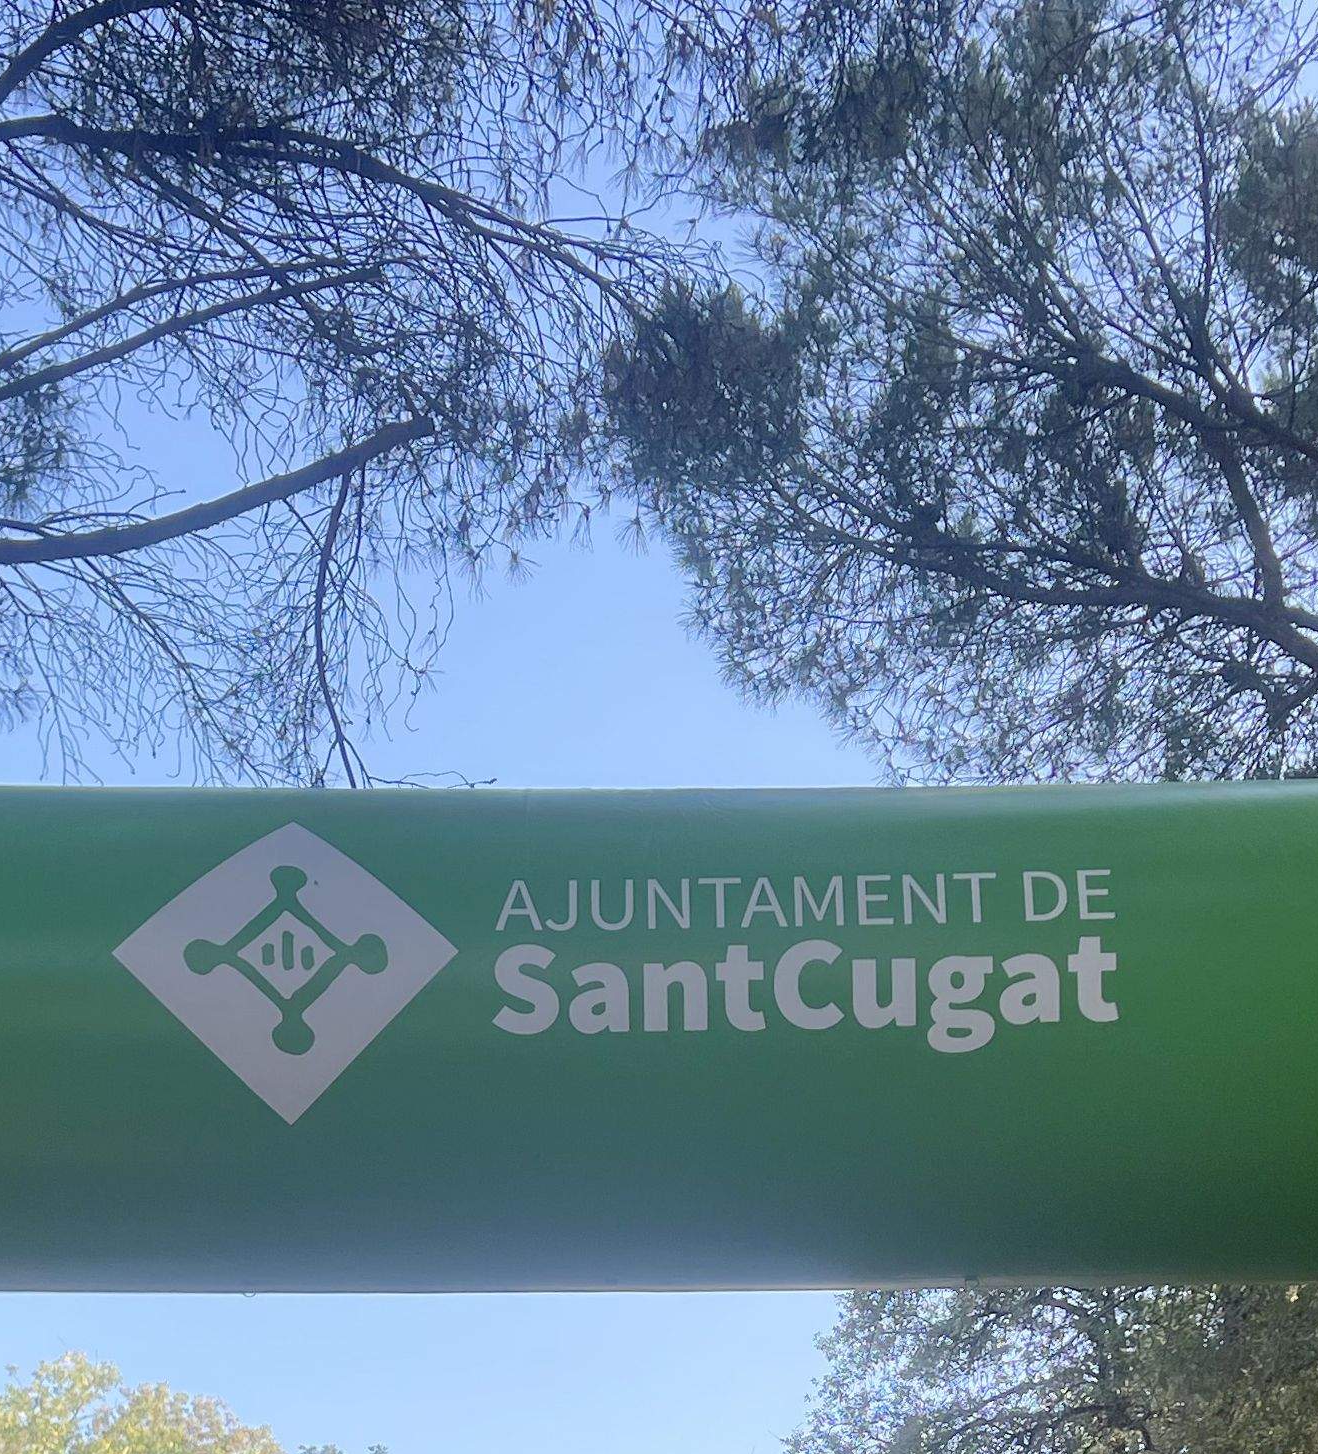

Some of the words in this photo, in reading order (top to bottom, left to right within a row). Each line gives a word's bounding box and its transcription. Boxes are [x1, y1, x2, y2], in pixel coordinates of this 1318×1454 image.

[495, 871, 997, 932] AJUNTAMENT
[1023, 868, 1117, 922] DE
[492, 934, 1121, 1053] SantCugat
